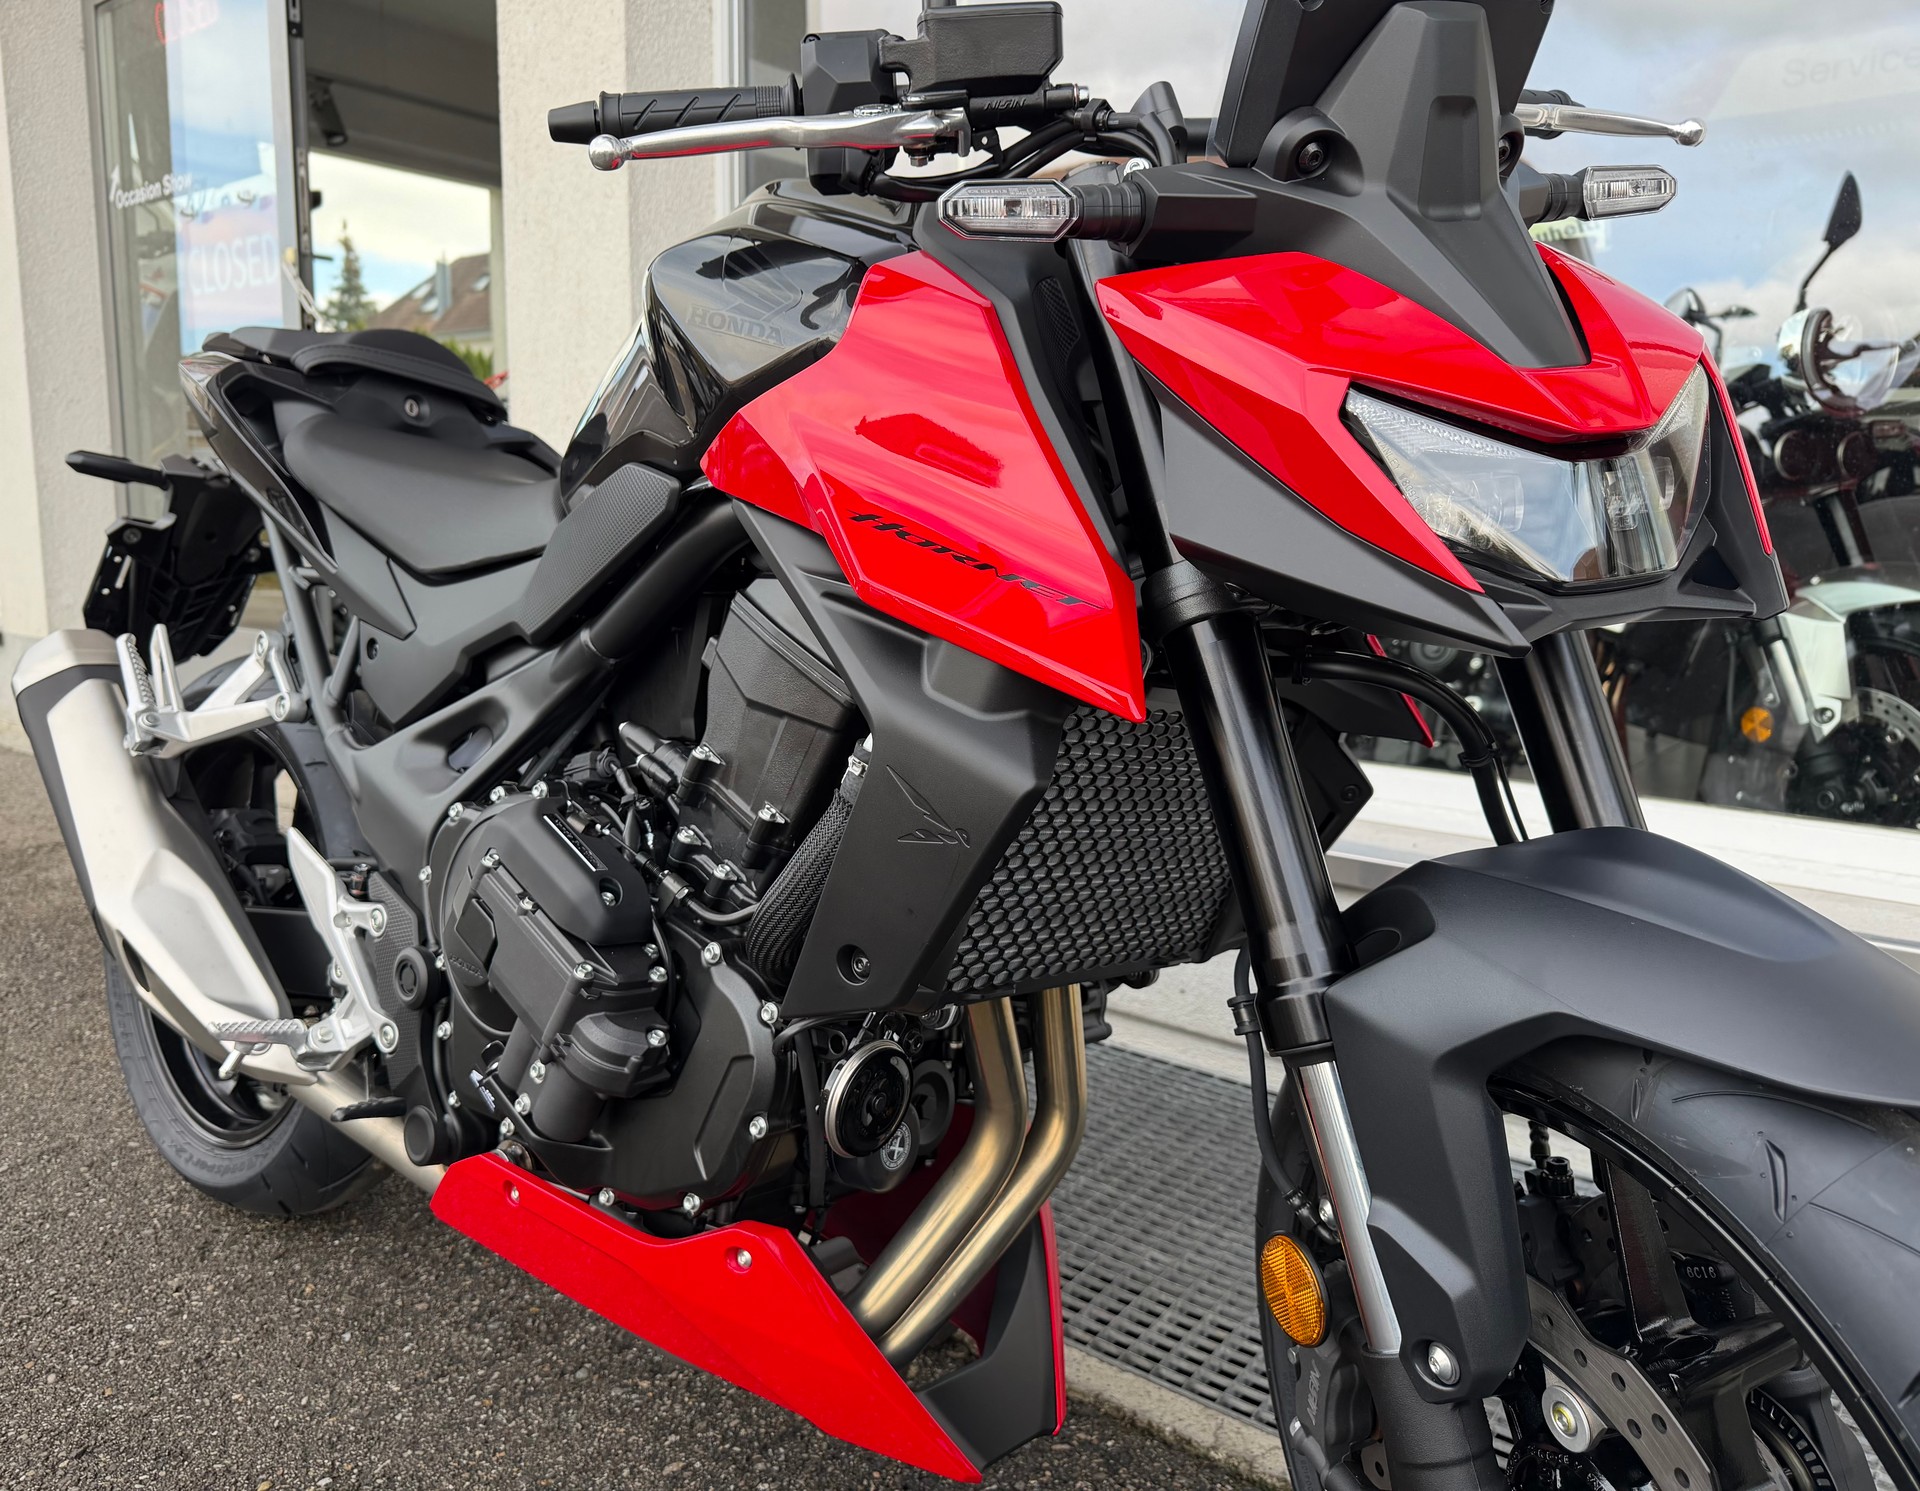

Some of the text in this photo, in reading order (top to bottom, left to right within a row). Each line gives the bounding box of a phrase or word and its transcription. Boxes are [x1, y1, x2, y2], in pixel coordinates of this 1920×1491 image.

[1782, 45, 1920, 88] Service
[115, 180, 162, 210] Occasion
[190, 233, 277, 295] CLOSED
[686, 304, 785, 349] HONDA
[848, 510, 1104, 609] HORNET
[449, 953, 484, 979] HONDA
